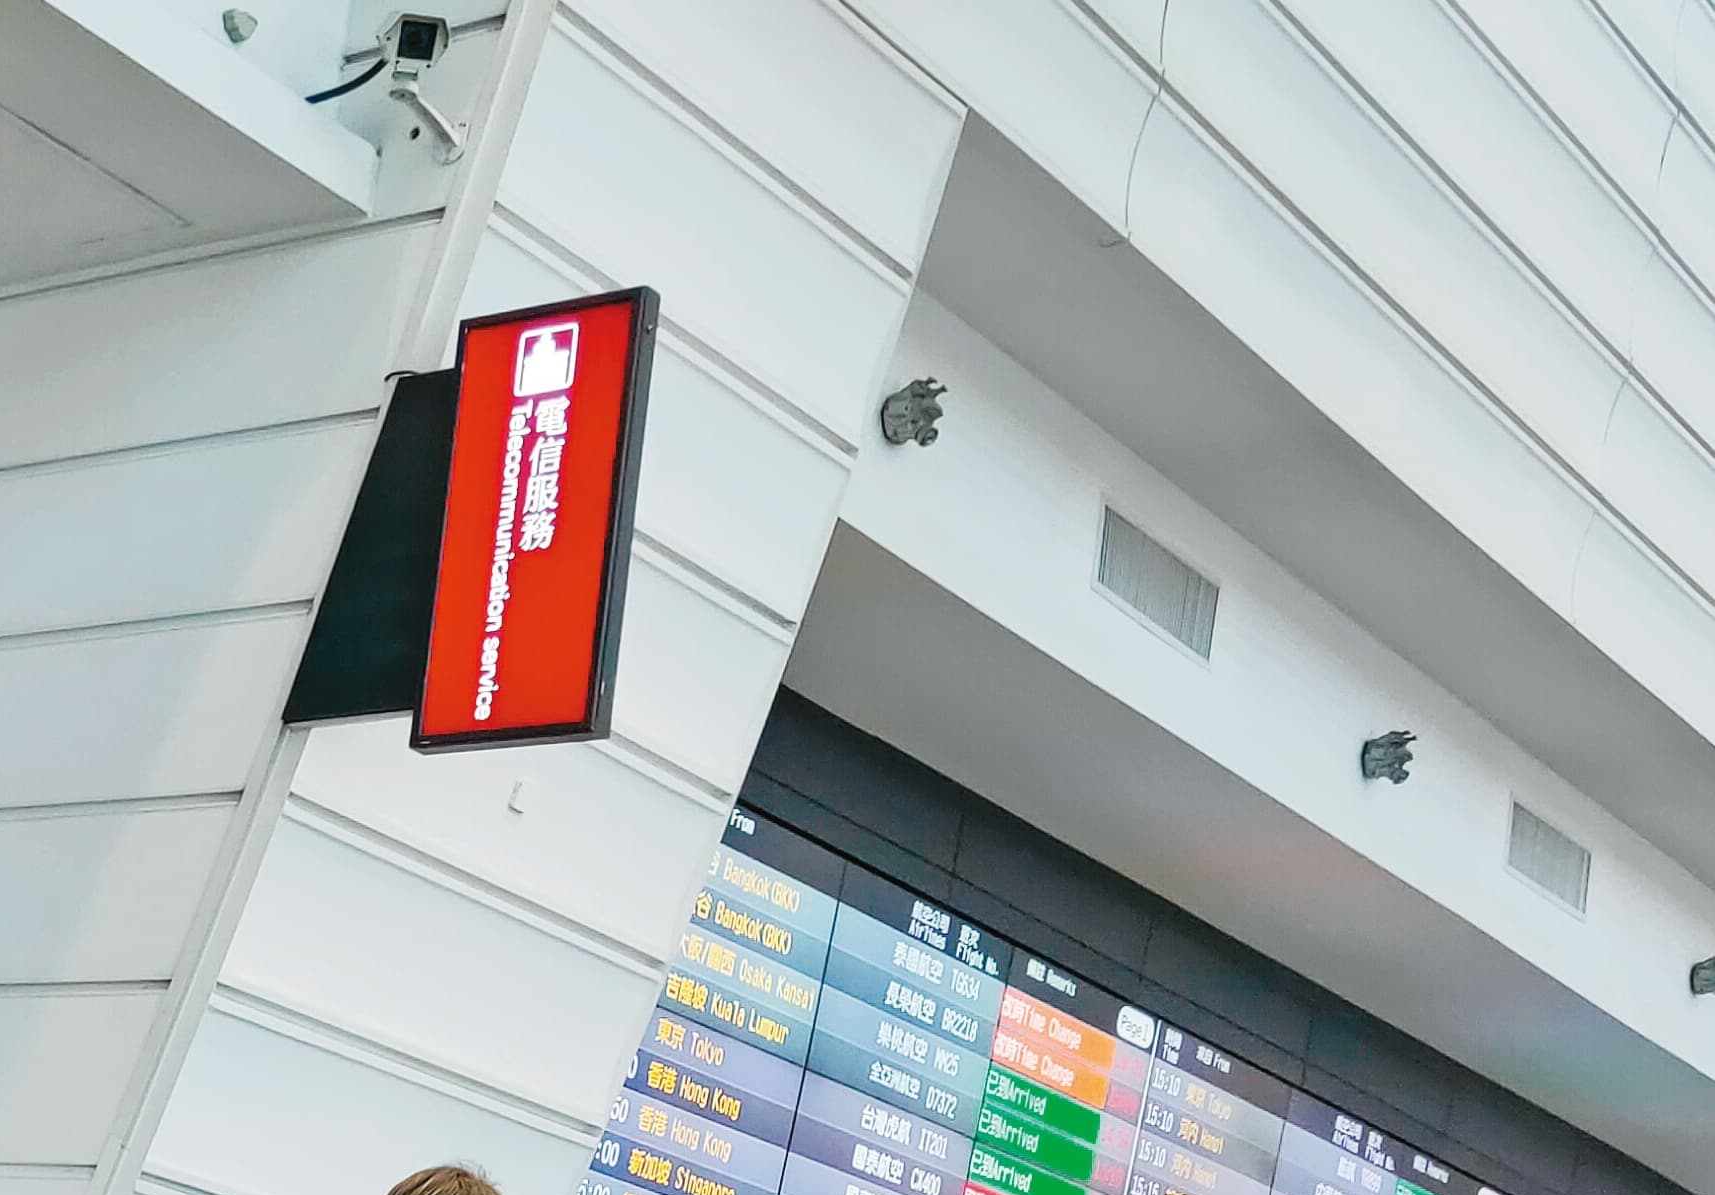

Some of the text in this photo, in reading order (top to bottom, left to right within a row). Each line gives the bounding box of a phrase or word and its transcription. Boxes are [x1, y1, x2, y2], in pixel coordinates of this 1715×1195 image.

[519, 394, 570, 553] 電信服務
[474, 398, 533, 721] Telecommunication service
[739, 959, 773, 994] Osaka
[665, 972, 709, 1012] 吉隆坡
[711, 991, 745, 1027] Kuala
[748, 1008, 790, 1045] Lumpur
[655, 1017, 686, 1052] 東京
[690, 1032, 725, 1067] Tokyo
[1151, 1067, 1181, 1096] 15:10
[638, 1104, 668, 1137] 香港
[670, 1117, 700, 1151] Hong
[703, 1130, 732, 1164] Kong
[647, 1060, 678, 1094] 香港
[679, 1074, 710, 1109] Hong
[712, 1088, 742, 1121] Kong
[851, 1143, 905, 1185] 國泰航空
[1145, 1102, 1174, 1133] 15:10
[627, 1148, 673, 1187] 新加坡
[1137, 1139, 1166, 1168] 15:10
